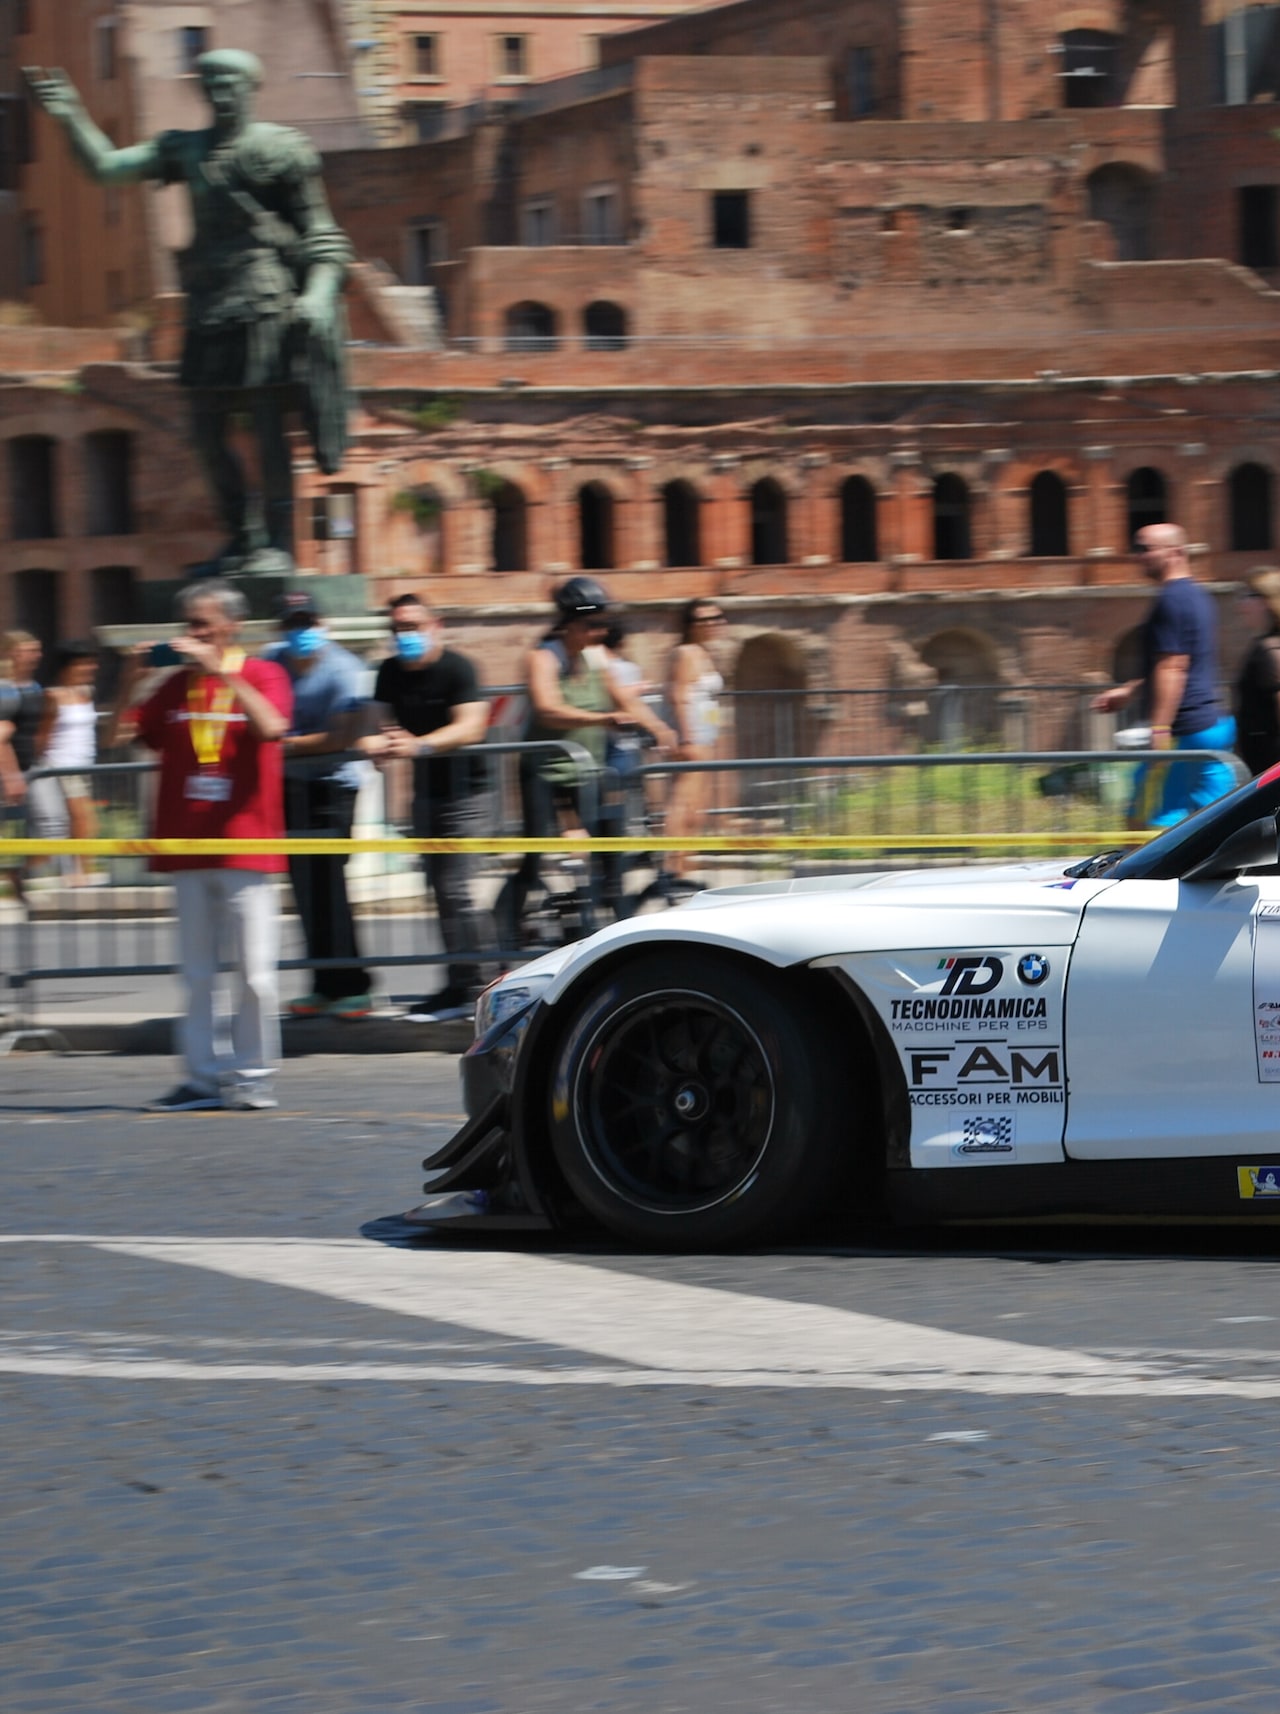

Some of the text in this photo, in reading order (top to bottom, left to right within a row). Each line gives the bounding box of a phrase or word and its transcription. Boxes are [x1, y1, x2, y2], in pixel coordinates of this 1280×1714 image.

[891, 998, 1047, 1019] TECNODINAMICA
[892, 1020, 1048, 1031] MACCHINE PER EPS
[911, 1046, 1060, 1085] FAM
[909, 1091, 1064, 1105] ACCESSORI PER MOBILI
